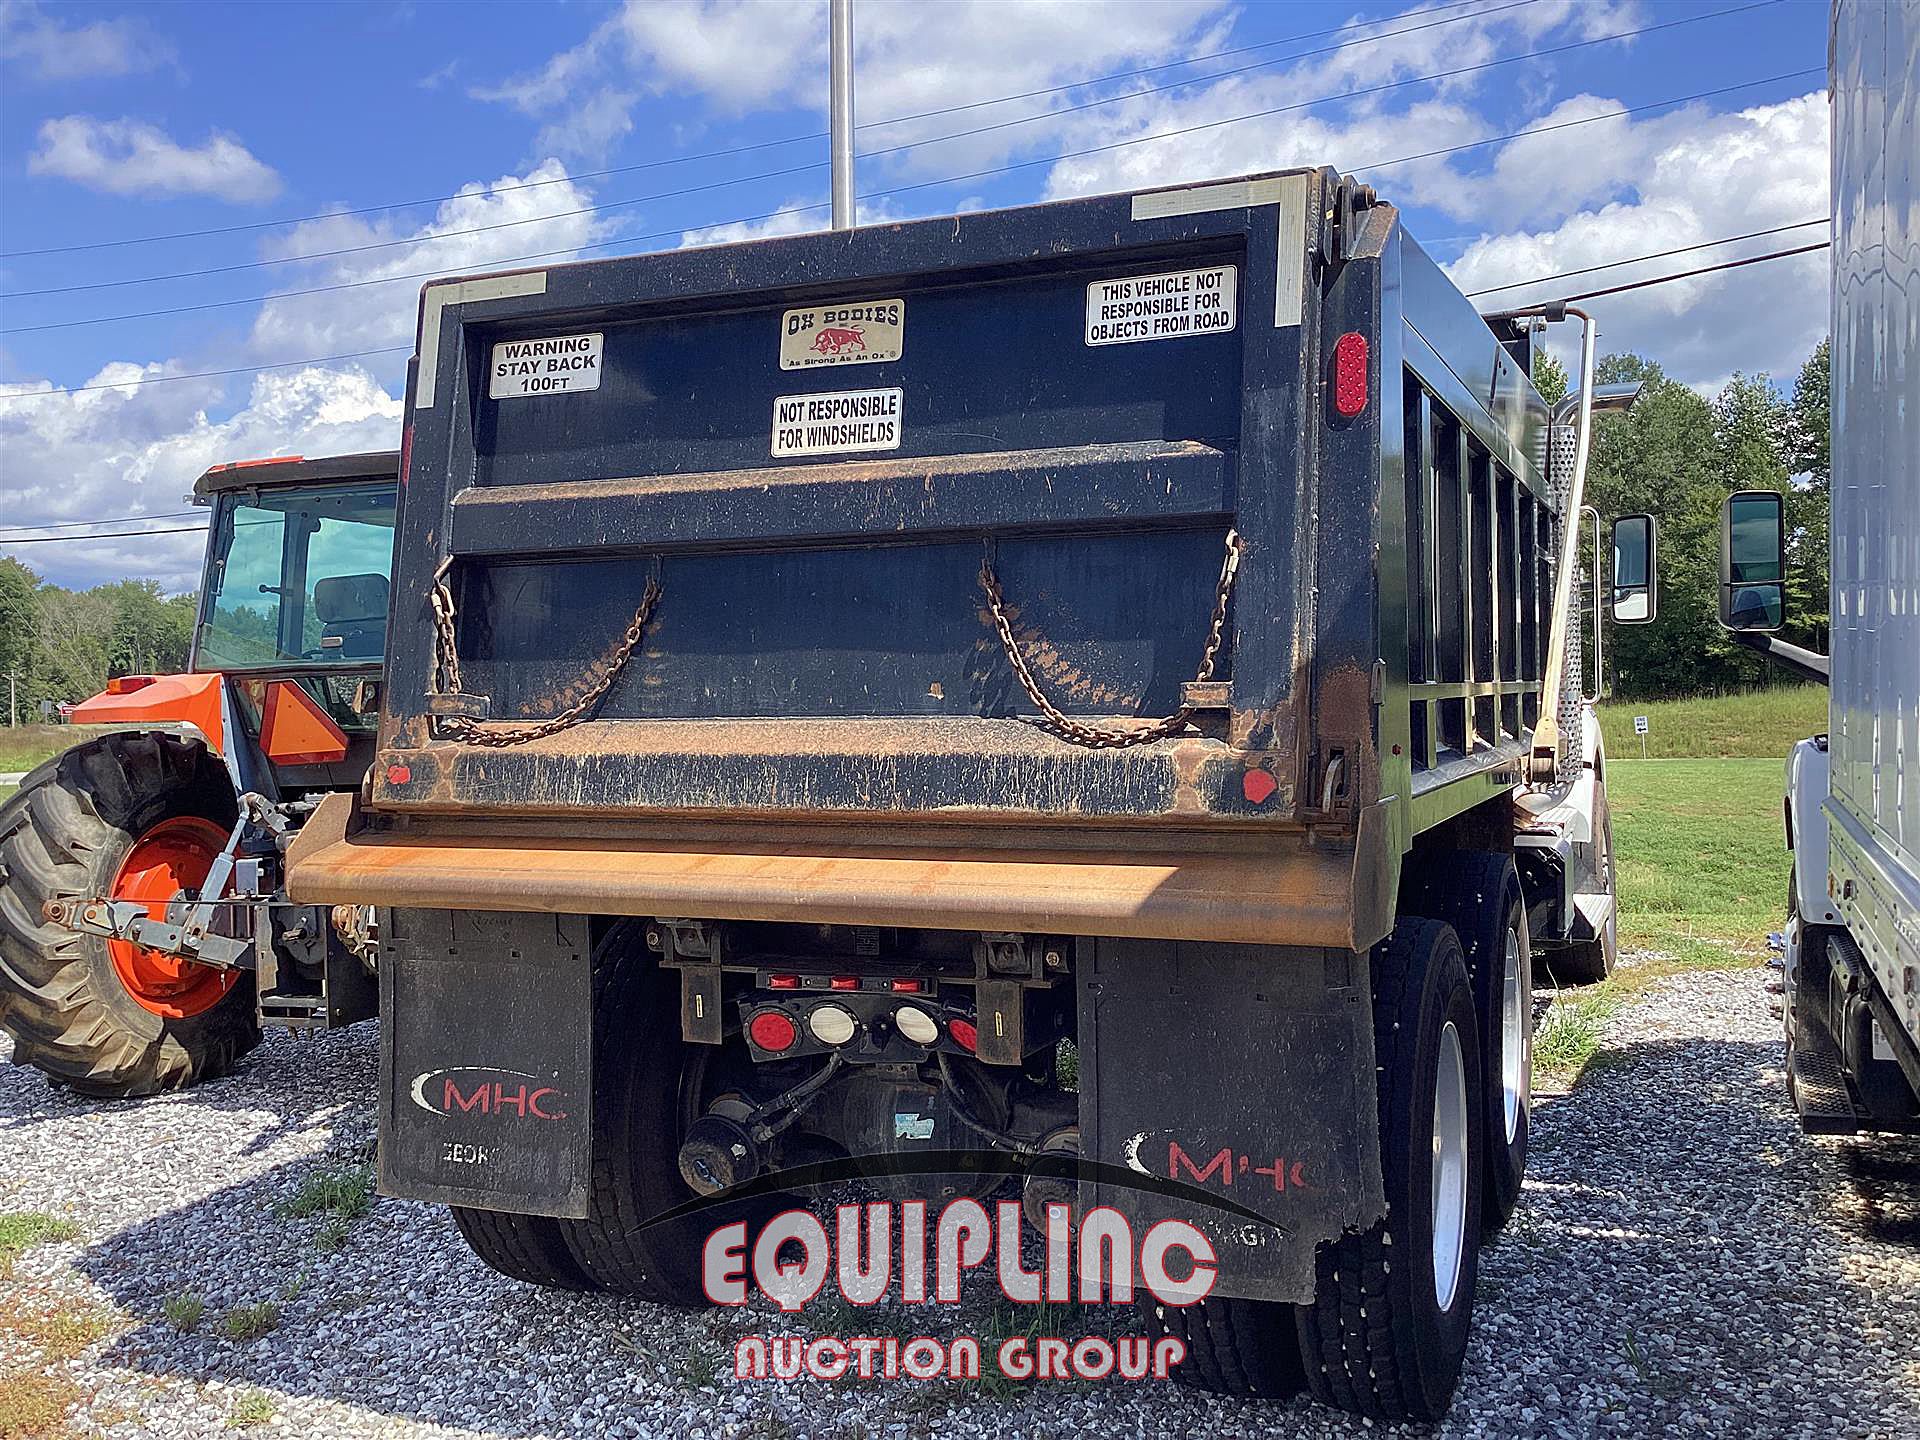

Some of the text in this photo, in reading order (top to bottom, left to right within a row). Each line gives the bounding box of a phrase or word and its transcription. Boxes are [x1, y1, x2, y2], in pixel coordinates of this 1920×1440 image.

[1102, 272, 1223, 301] THIS VEHICLE NOT
[788, 305, 898, 335] OX BODIES
[1101, 292, 1220, 320] RESPONSIBLE FOR
[1091, 311, 1229, 341] OBJECTS FROM ROAD
[505, 338, 590, 359] WARNING
[804, 355, 836, 366] Strong
[497, 354, 596, 377] STAY BACK
[521, 377, 570, 392] 100FT
[780, 395, 897, 423] NOT RESPONSIBLE
[779, 421, 894, 449] FOR WINDSHIELDS
[443, 1078, 568, 1120] MHC
